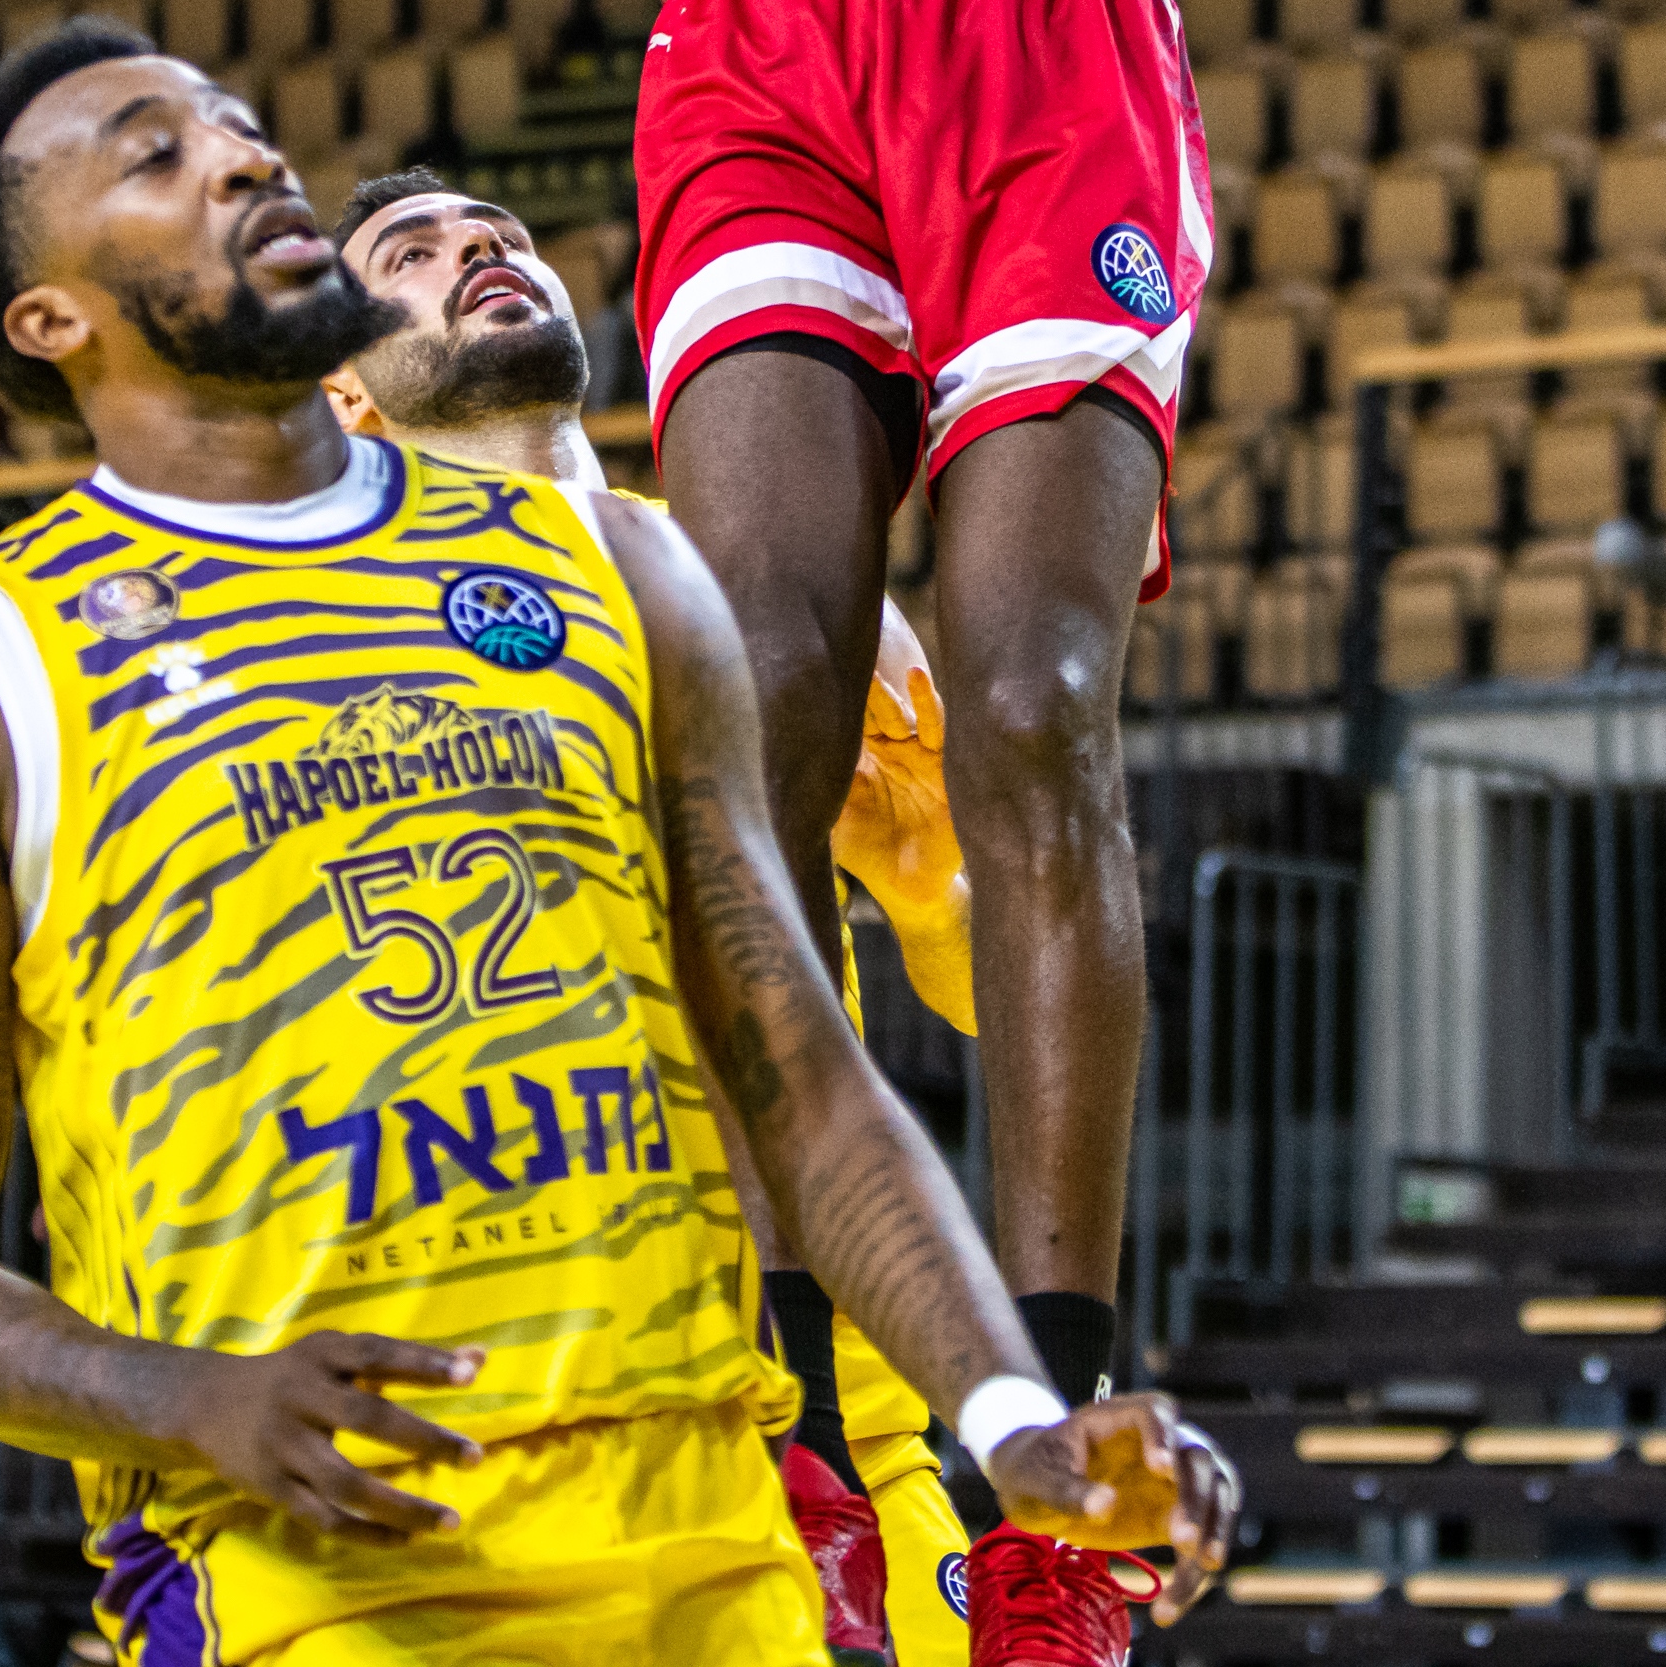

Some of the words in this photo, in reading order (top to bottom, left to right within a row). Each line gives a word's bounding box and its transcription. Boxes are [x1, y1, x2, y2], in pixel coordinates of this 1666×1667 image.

[318, 827, 564, 1027] 52
[277, 1063, 673, 1226] נתנאל
[346, 1211, 568, 1276] NETANEL
